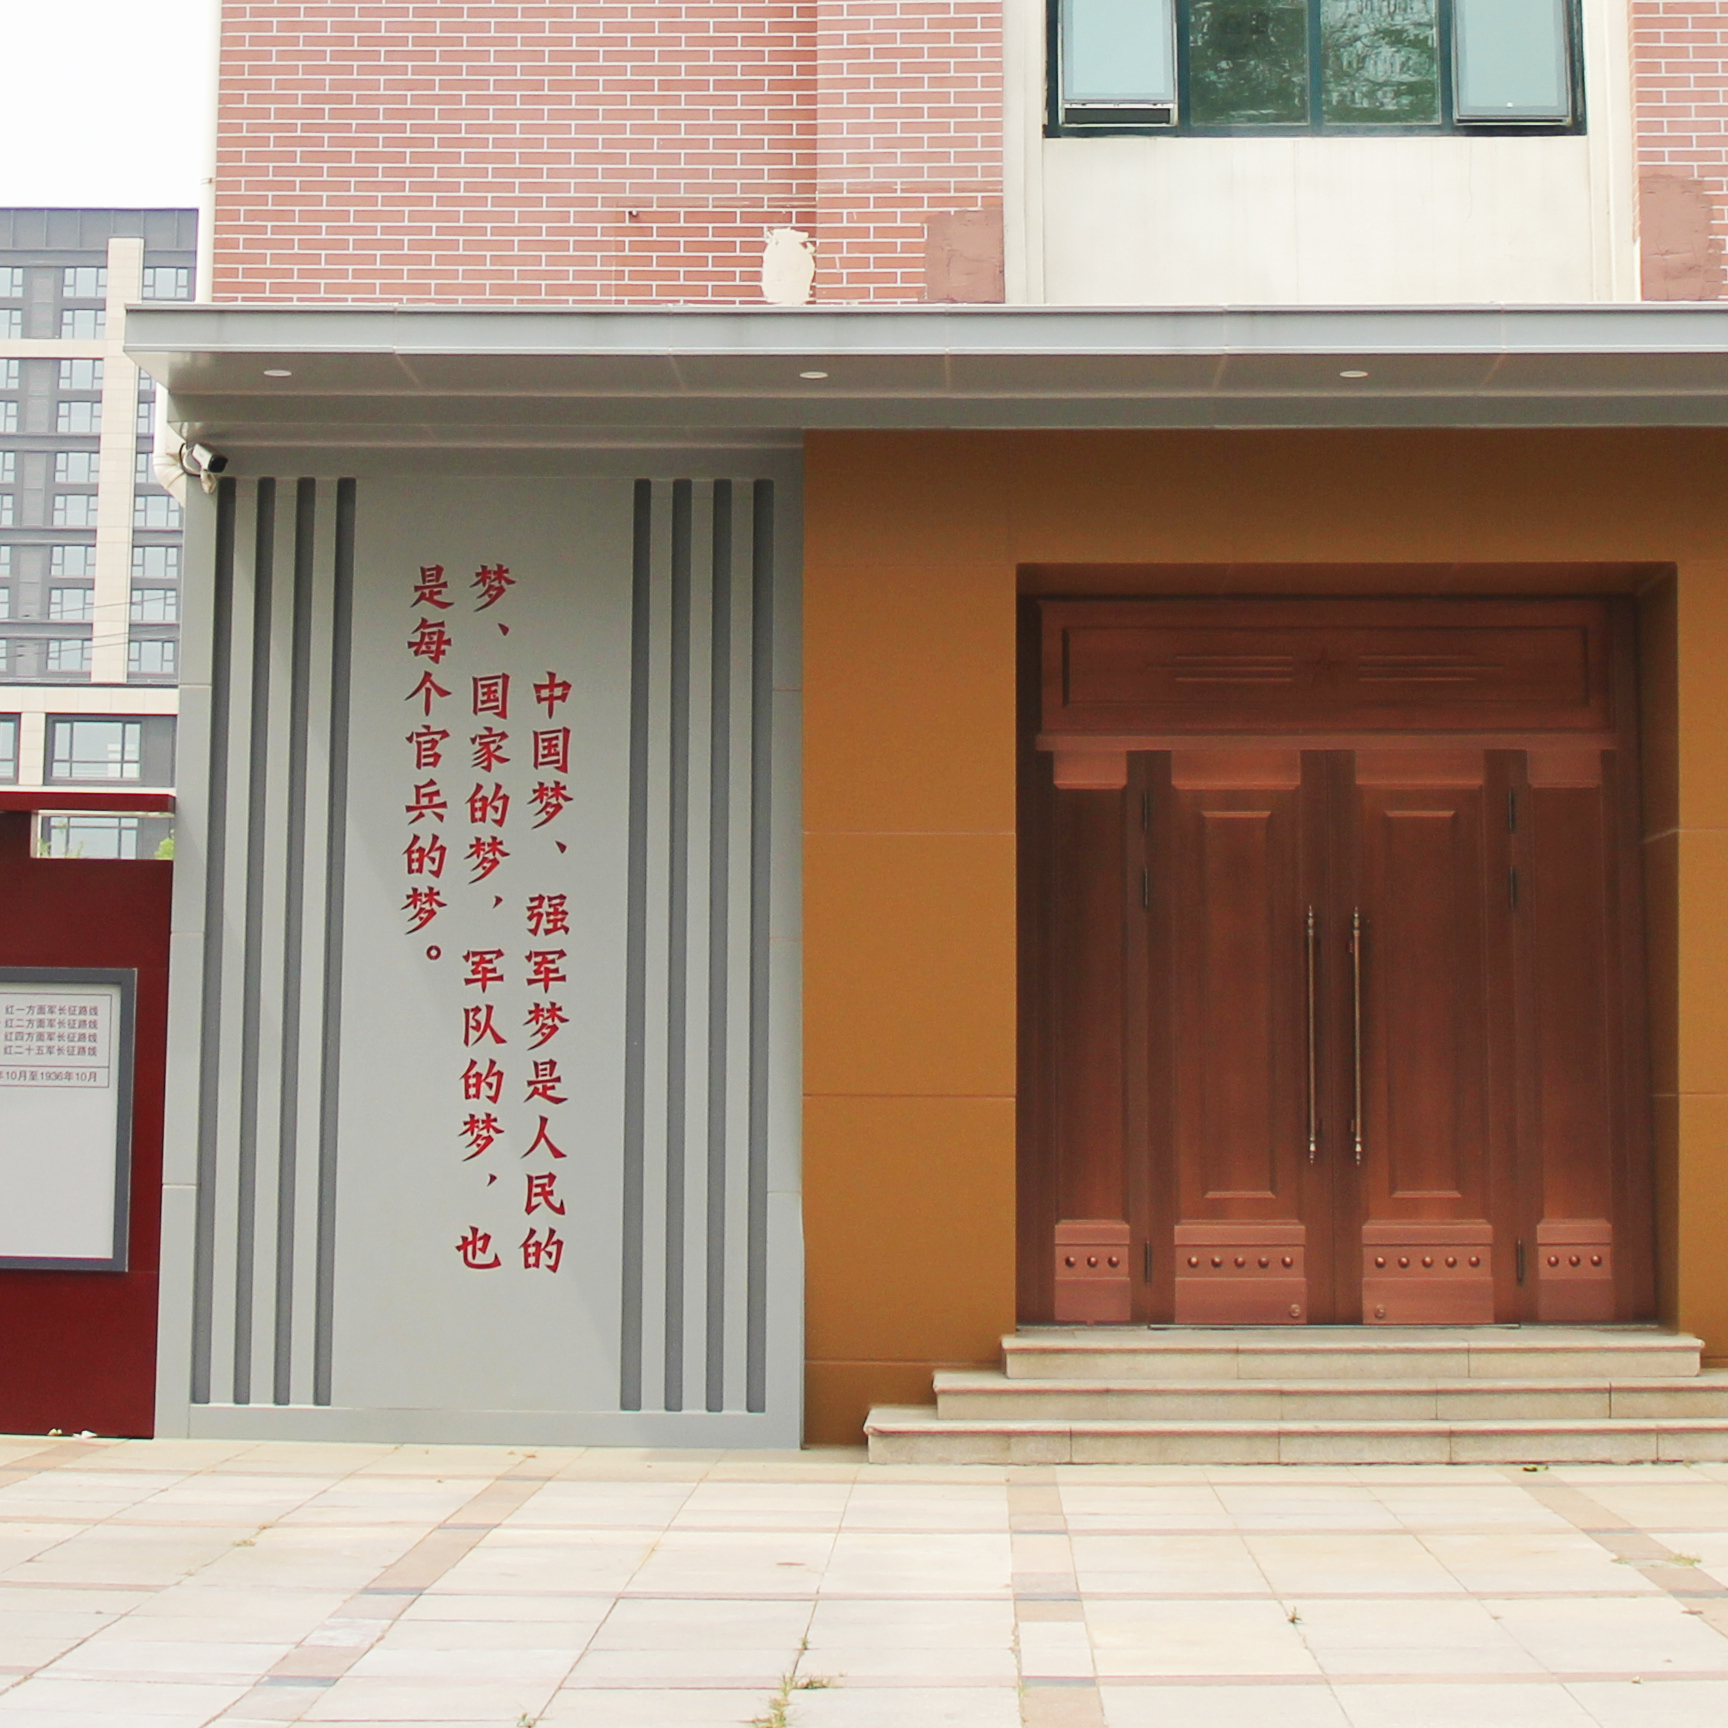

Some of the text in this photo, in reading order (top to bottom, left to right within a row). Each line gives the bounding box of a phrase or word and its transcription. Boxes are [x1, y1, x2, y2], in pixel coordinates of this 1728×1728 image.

[404, 564, 454, 961] 是每个官兵的梦。
[456, 563, 517, 1270] 梦、国家的梦，军队的梦，也
[521, 672, 573, 1273] 中国梦、强军梦是人民的
[5, 1005, 98, 1016] 红一方面军长征路线
[4, 1018, 98, 1030] 红二方面军长征路线
[3, 1032, 98, 1043] 红四方面军长征路线
[3, 1045, 97, 1057] 红二十五军长征路线
